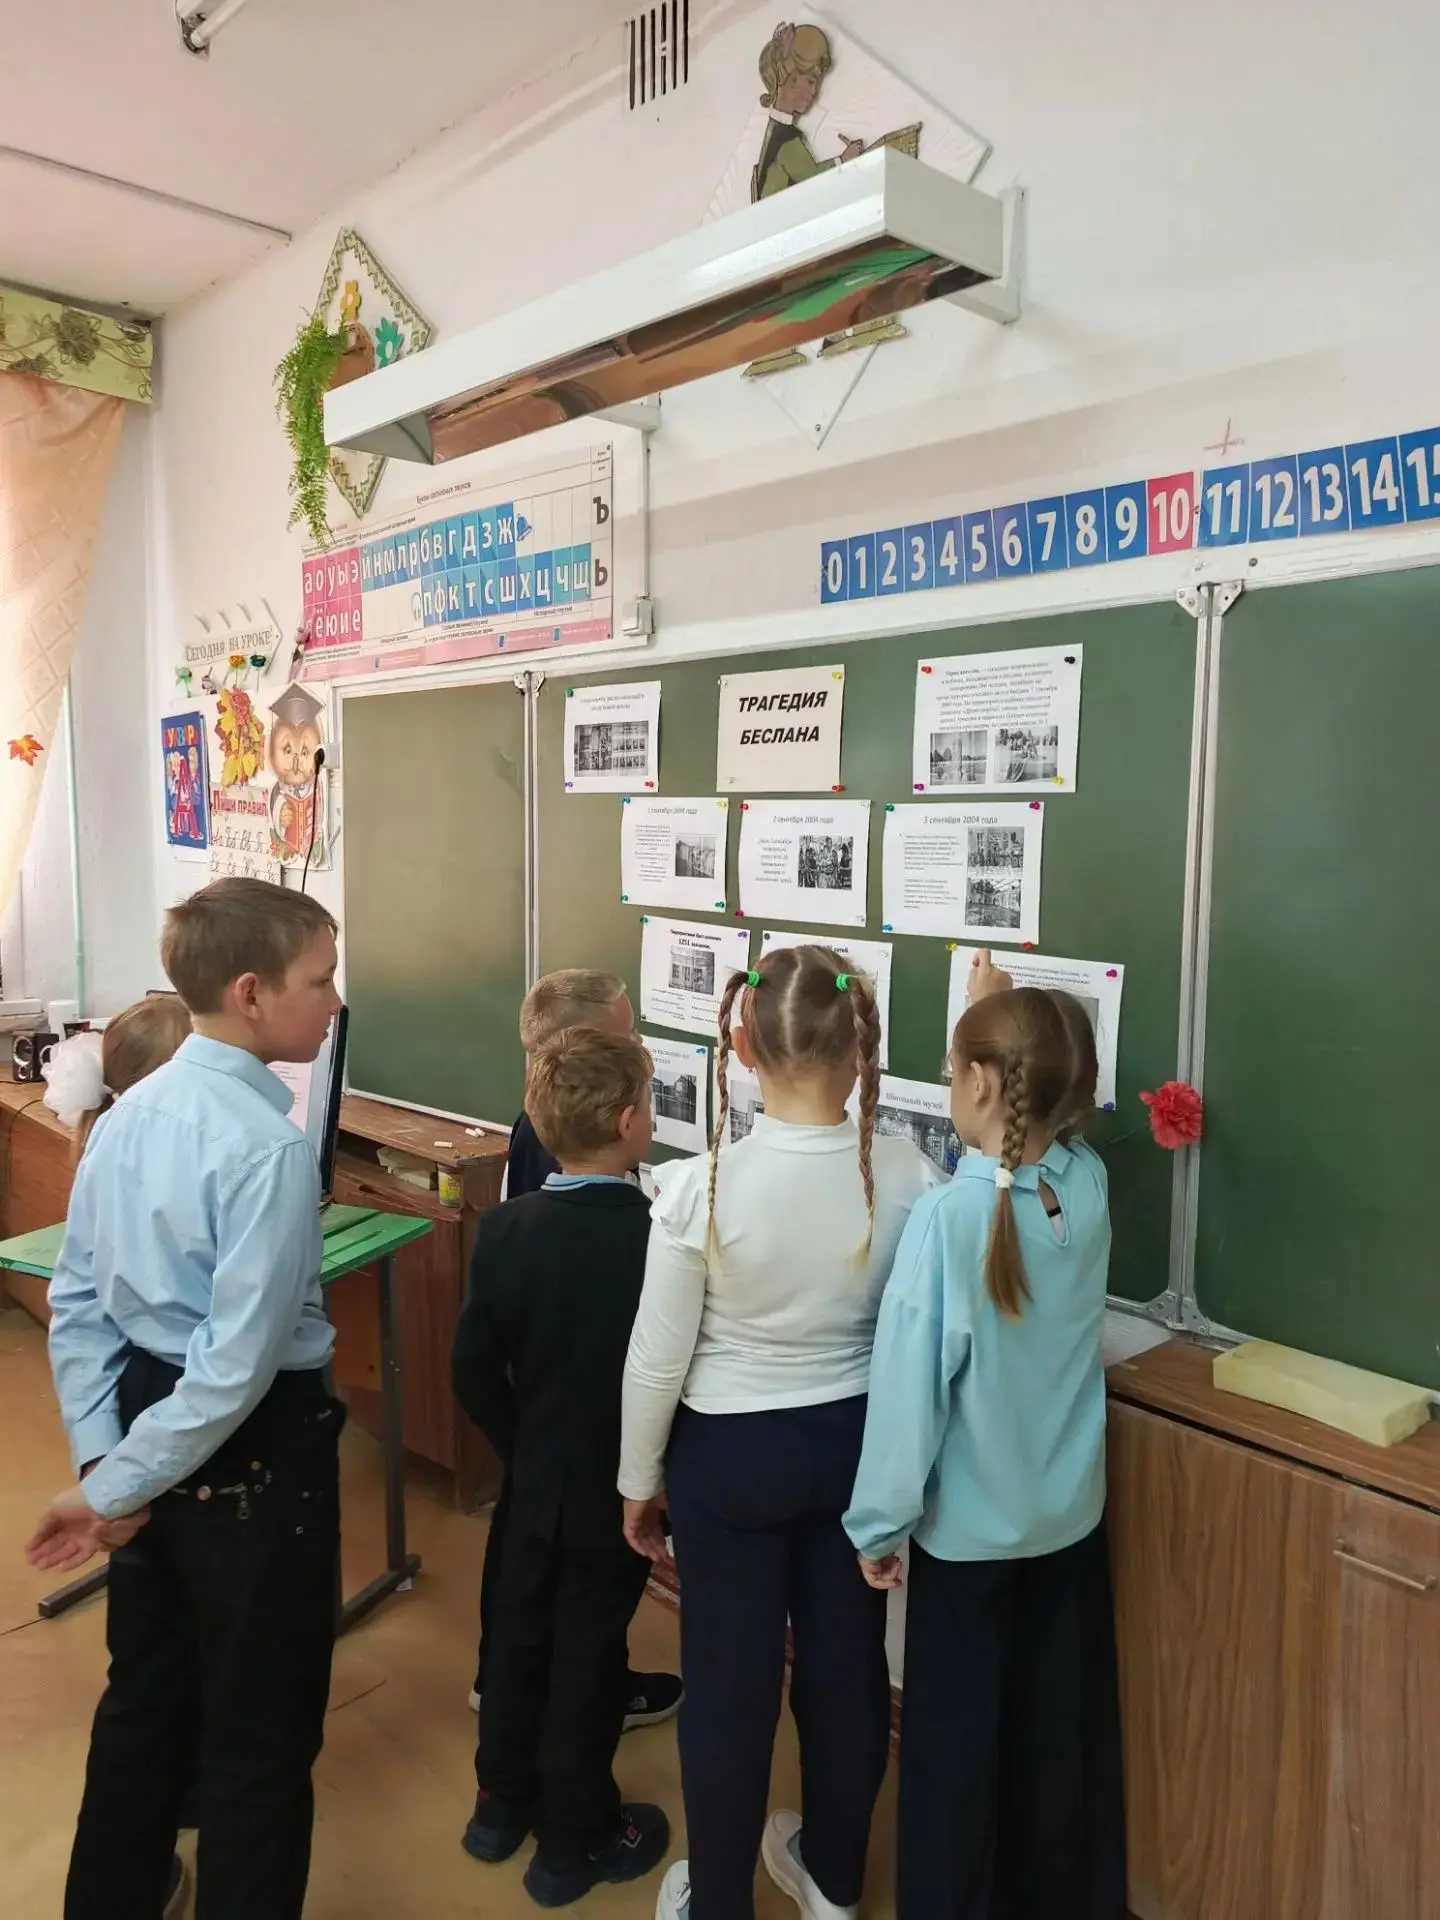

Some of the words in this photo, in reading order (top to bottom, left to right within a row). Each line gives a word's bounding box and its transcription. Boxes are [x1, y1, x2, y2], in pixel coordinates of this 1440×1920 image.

[827, 552, 843, 594] 0
[854, 546, 866, 589] 1
[881, 542, 897, 586] 2
[910, 537, 926, 582] 3
[940, 531, 958, 576] 4
[971, 525, 988, 572] 5
[1002, 518, 1022, 567] 6
[1036, 512, 1057, 561] 7
[1075, 504, 1098, 556] 8
[1115, 498, 1138, 550] 9
[1152, 488, 1190, 544] 10
[1206, 479, 1242, 536] 11
[1256, 470, 1296, 529] 12
[1304, 463, 1344, 522] 13
[1351, 454, 1400, 515] 14
[739, 690, 828, 713] ТРАГЕДИЯ
[739, 725, 820, 745] БЕСЛАНА
[804, 815, 818, 824] 2004
[929, 815, 961, 825] сентября
[962, 815, 980, 824] 2004
[981, 816, 998, 825] года
[678, 938, 690, 946] 1251
